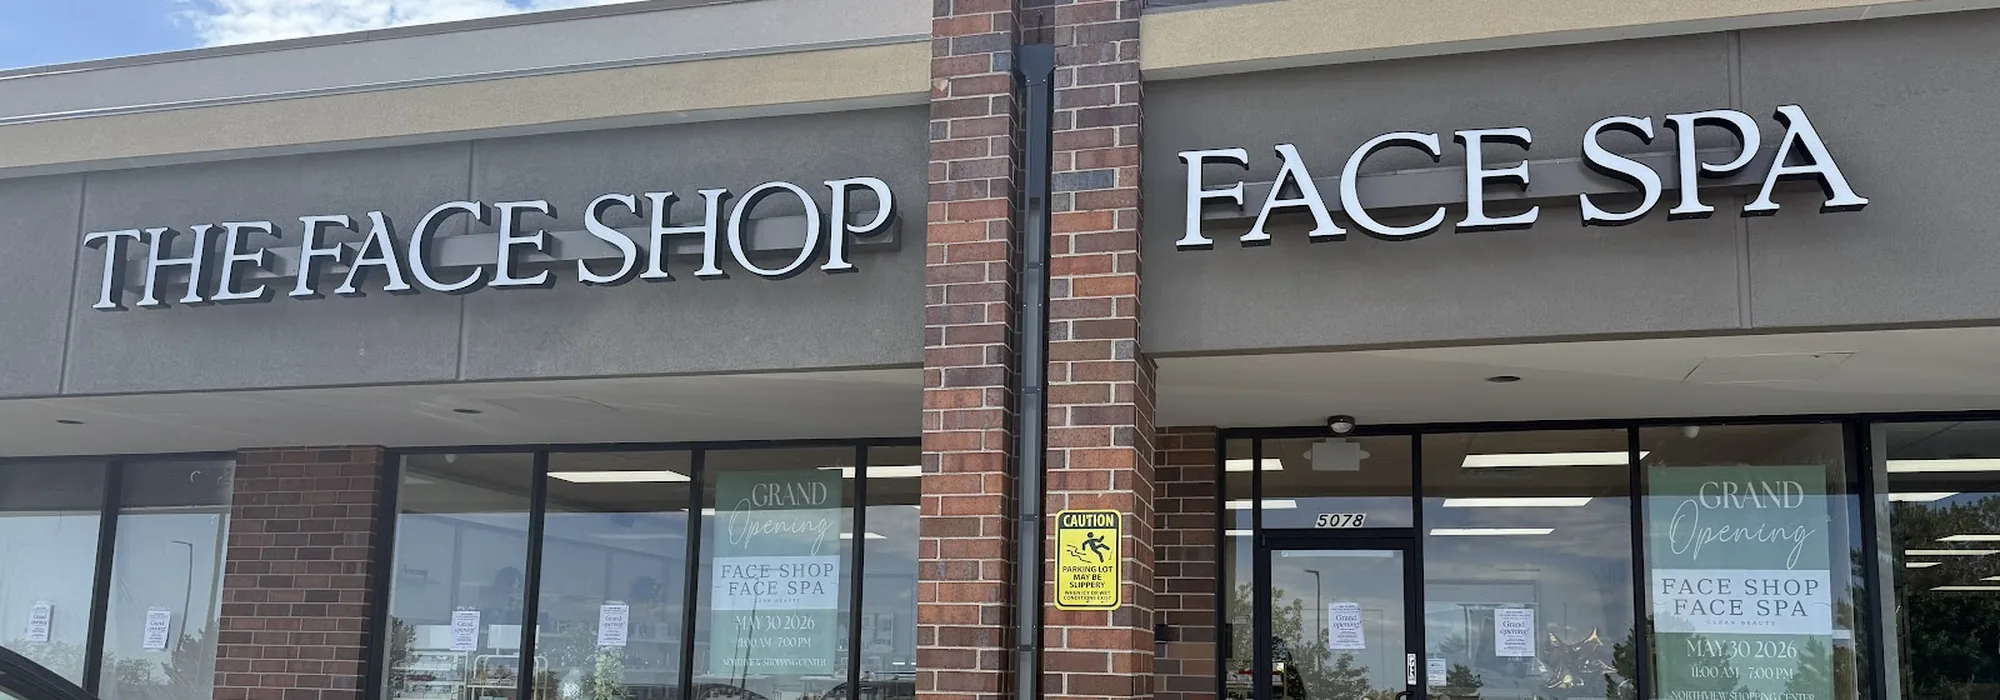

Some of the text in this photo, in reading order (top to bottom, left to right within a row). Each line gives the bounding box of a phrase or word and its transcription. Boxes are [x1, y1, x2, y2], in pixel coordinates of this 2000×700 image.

[1175, 104, 1869, 249] FACE SPA
[83, 176, 893, 309] THE FACE SHOP
[752, 482, 827, 507] GRAND
[1699, 480, 1804, 510] GRAND
[728, 498, 833, 556] Opening
[1063, 514, 1114, 527] CAUTION
[1317, 514, 1364, 527] 5078
[1669, 499, 1816, 570] Opening
[721, 563, 834, 579] FACE SHOP
[728, 580, 825, 596] FACE SPA
[1661, 578, 1819, 596] FACE SHOP
[1674, 598, 1808, 617] FACE SPA
[735, 615, 815, 632] MAY 30 2026
[1502, 620, 1526, 628] Grand
[798, 637, 812, 648] PM
[1686, 639, 1797, 660] MAY 30 2026
[1691, 665, 1794, 680] 11:00 AM 7:00 PM
[1670, 690, 1726, 700] NORTHVIEW
[1729, 691, 1776, 700] SHOPPING
